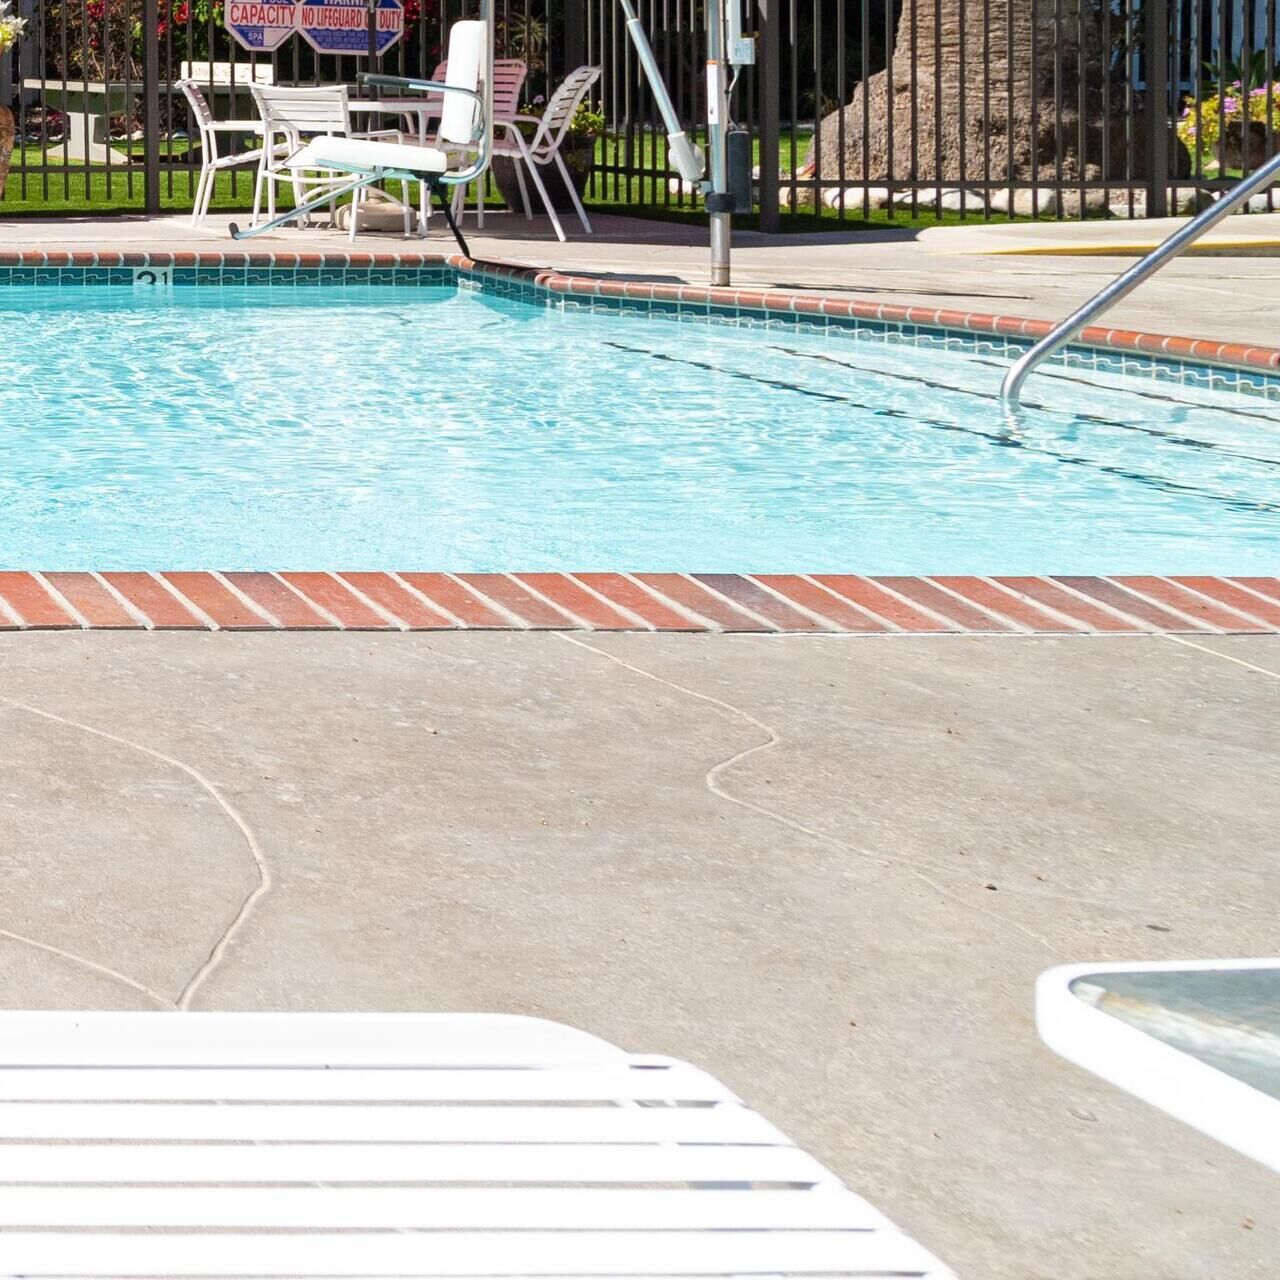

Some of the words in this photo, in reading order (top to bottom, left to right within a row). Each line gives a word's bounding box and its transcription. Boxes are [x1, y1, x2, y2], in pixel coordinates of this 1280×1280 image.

[230, 4, 296, 25] CAPACITY
[301, 7, 315, 26] NO
[317, 8, 362, 27] LIFEGUARD
[379, 10, 401, 29] DUTY
[248, 32, 263, 41] SPA
